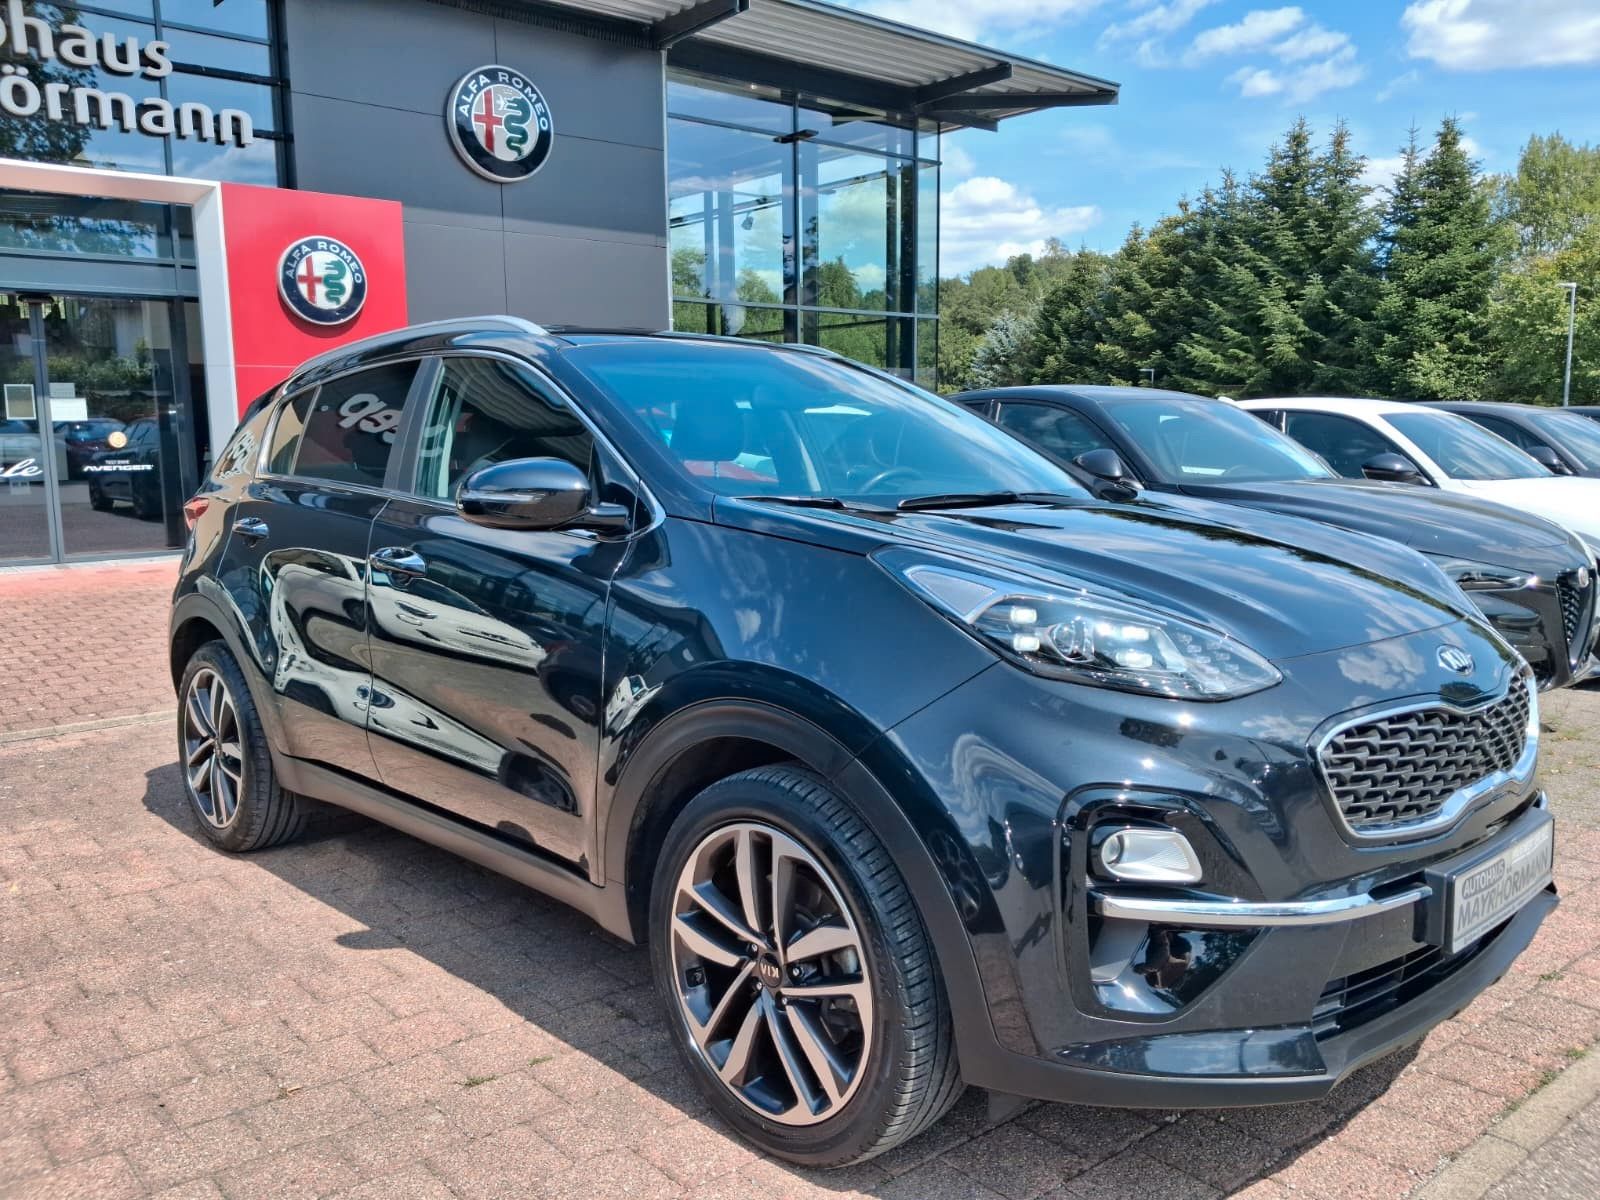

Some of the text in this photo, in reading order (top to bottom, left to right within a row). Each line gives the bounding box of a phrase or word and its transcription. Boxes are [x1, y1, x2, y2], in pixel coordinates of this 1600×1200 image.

[0, 0, 173, 77] haus
[458, 71, 549, 130] ALFA ROMEO
[285, 240, 362, 283] ALFA ROMEO
[0, 458, 43, 477] le
[1456, 846, 1548, 931] MAYRHÖRMANN
[1463, 861, 1505, 896] AUTOHAUS
